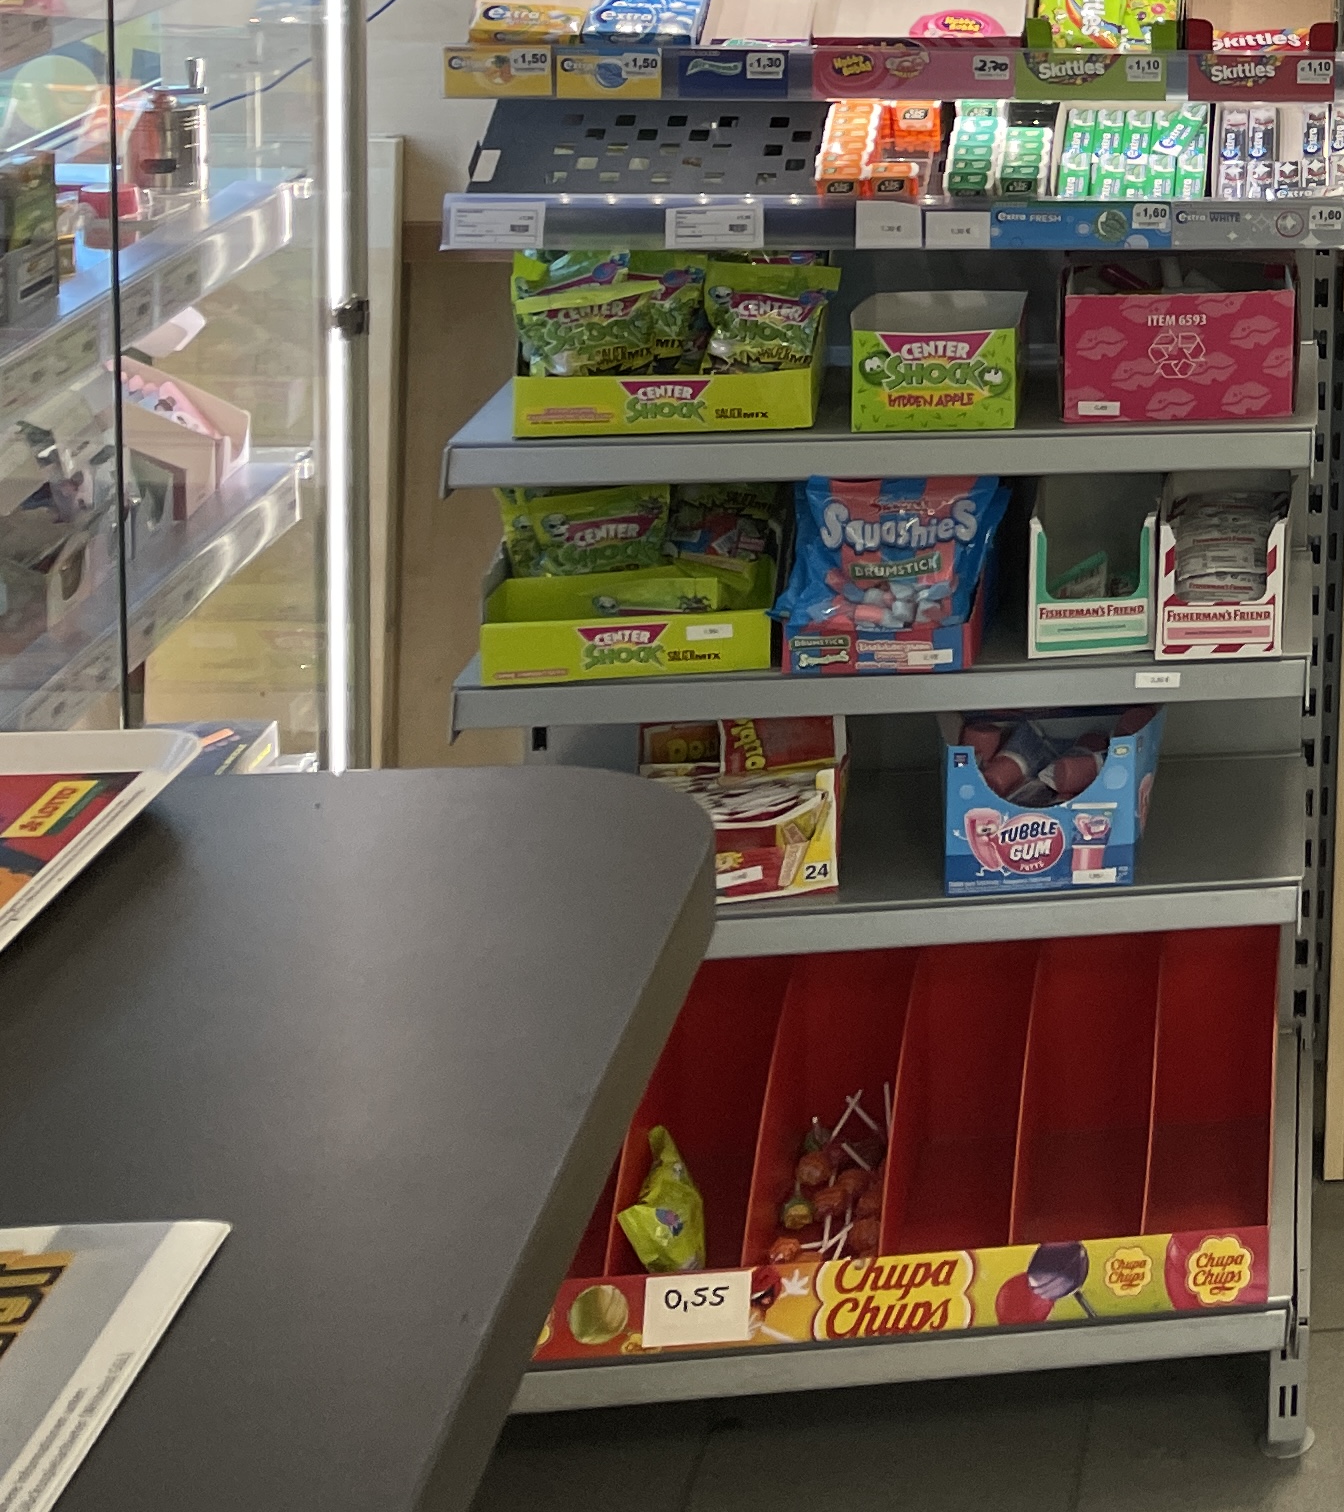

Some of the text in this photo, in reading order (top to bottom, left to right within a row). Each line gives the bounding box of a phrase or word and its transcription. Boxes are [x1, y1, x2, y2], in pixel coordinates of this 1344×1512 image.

[488, 7, 540, 22] extra
[1212, 32, 1301, 52] Skittles
[1038, 59, 1106, 81] Skittles
[1210, 62, 1276, 83] Skittles
[997, 210, 1062, 224] extra FRESH
[1176, 210, 1240, 224] extra WHITE
[558, 301, 625, 323] CENTER
[1147, 314, 1207, 327] ITEM 6593
[656, 338, 684, 349] MIX
[901, 340, 970, 360] CENTER
[883, 354, 988, 389] SHOCK
[636, 385, 692, 400] CENTER
[936, 393, 974, 407] APPLE
[625, 398, 706, 424] SHOCK
[573, 523, 641, 547] CENTER
[853, 558, 939, 579] DRUMSTICK
[1039, 603, 1145, 621] FISHERMAN'S FRIEND
[1166, 609, 1271, 624] FISHERMAN'S FRIEND
[594, 630, 651, 645] CENTER
[794, 637, 846, 648] DRUMSTICK
[582, 643, 666, 668] SHOCK
[1000, 821, 1058, 847] TUBBLE
[1009, 839, 1053, 863] GUM
[805, 864, 828, 880] 24
[1110, 1257, 1148, 1272] Chupa
[1195, 1252, 1246, 1269] Chupa
[834, 1256, 961, 1301] Chupa
[1108, 1269, 1146, 1285] Chups
[1193, 1268, 1242, 1286] Chups
[663, 1286, 730, 1312] 0,55
[826, 1296, 950, 1341] Chups
